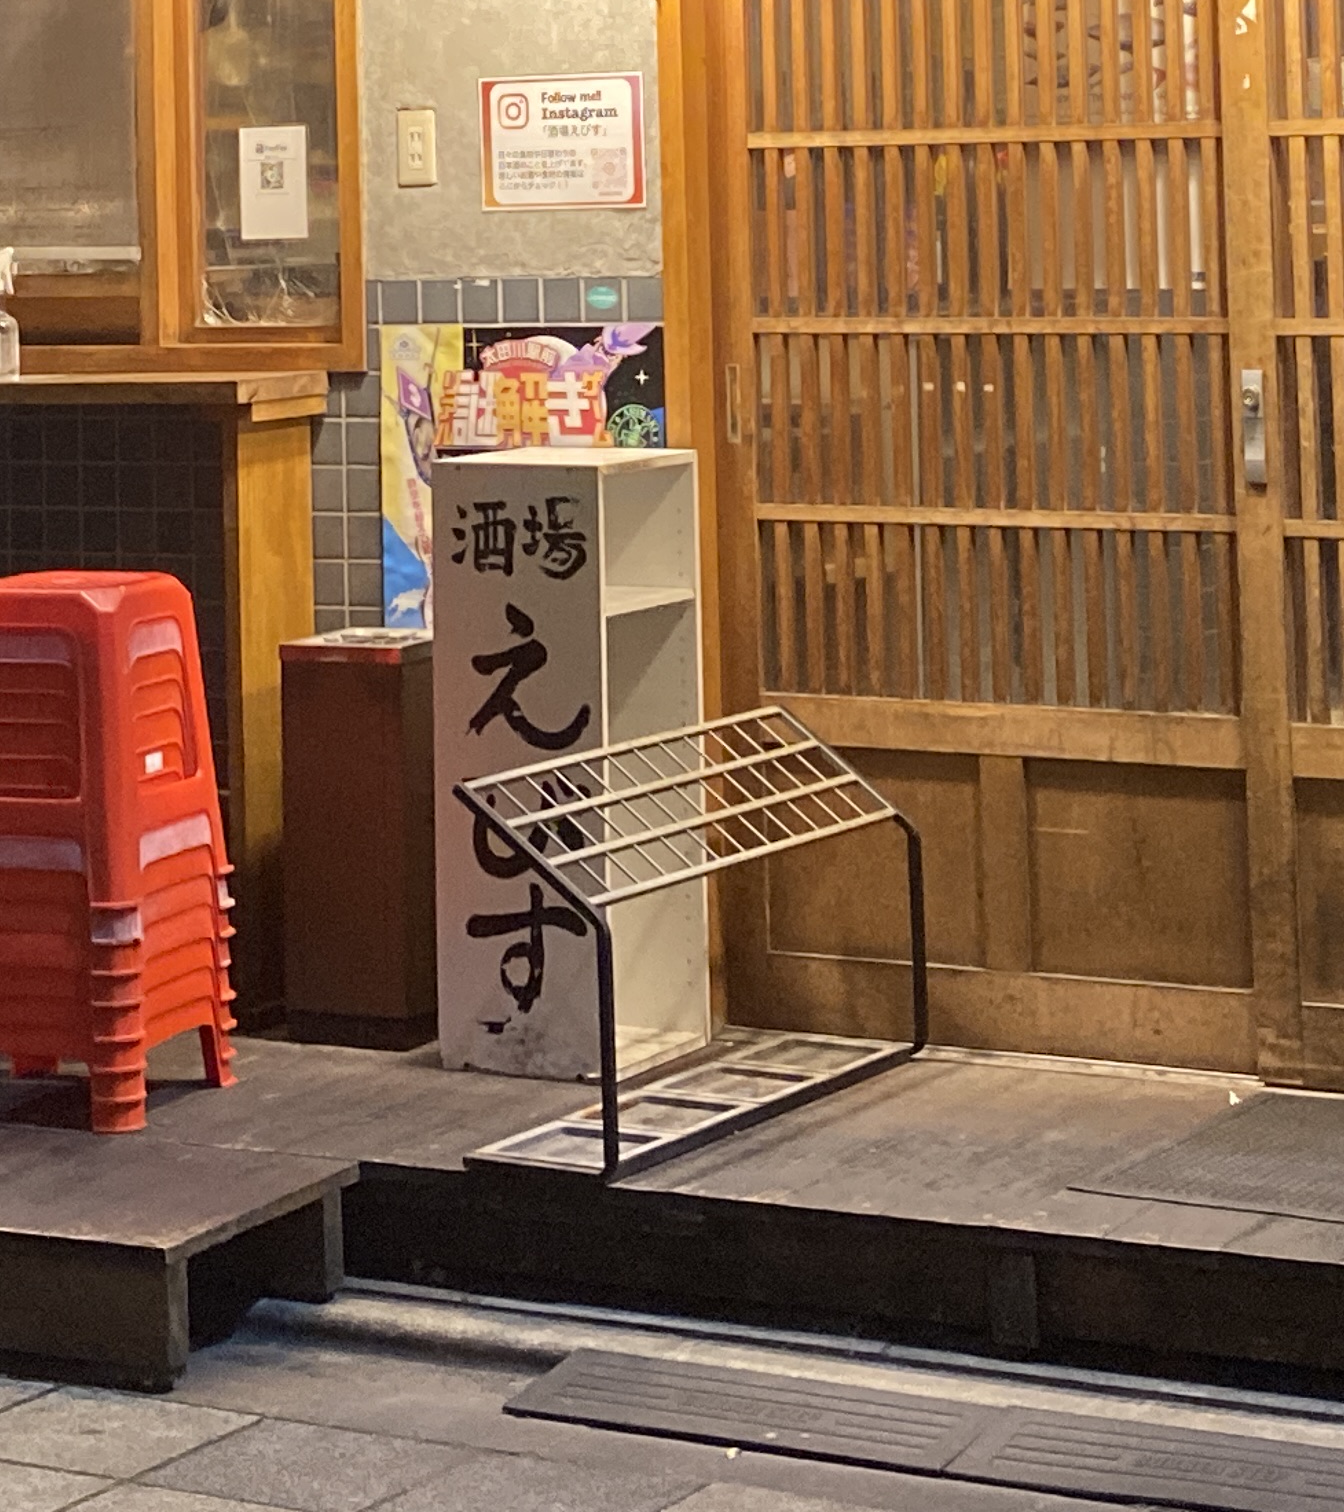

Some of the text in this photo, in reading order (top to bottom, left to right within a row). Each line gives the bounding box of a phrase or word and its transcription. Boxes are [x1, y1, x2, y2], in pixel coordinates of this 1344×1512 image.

[541, 91, 577, 104] Follow
[541, 106, 619, 121] Instagram
[451, 496, 587, 580] 酒場
[465, 602, 591, 1034] えびす
